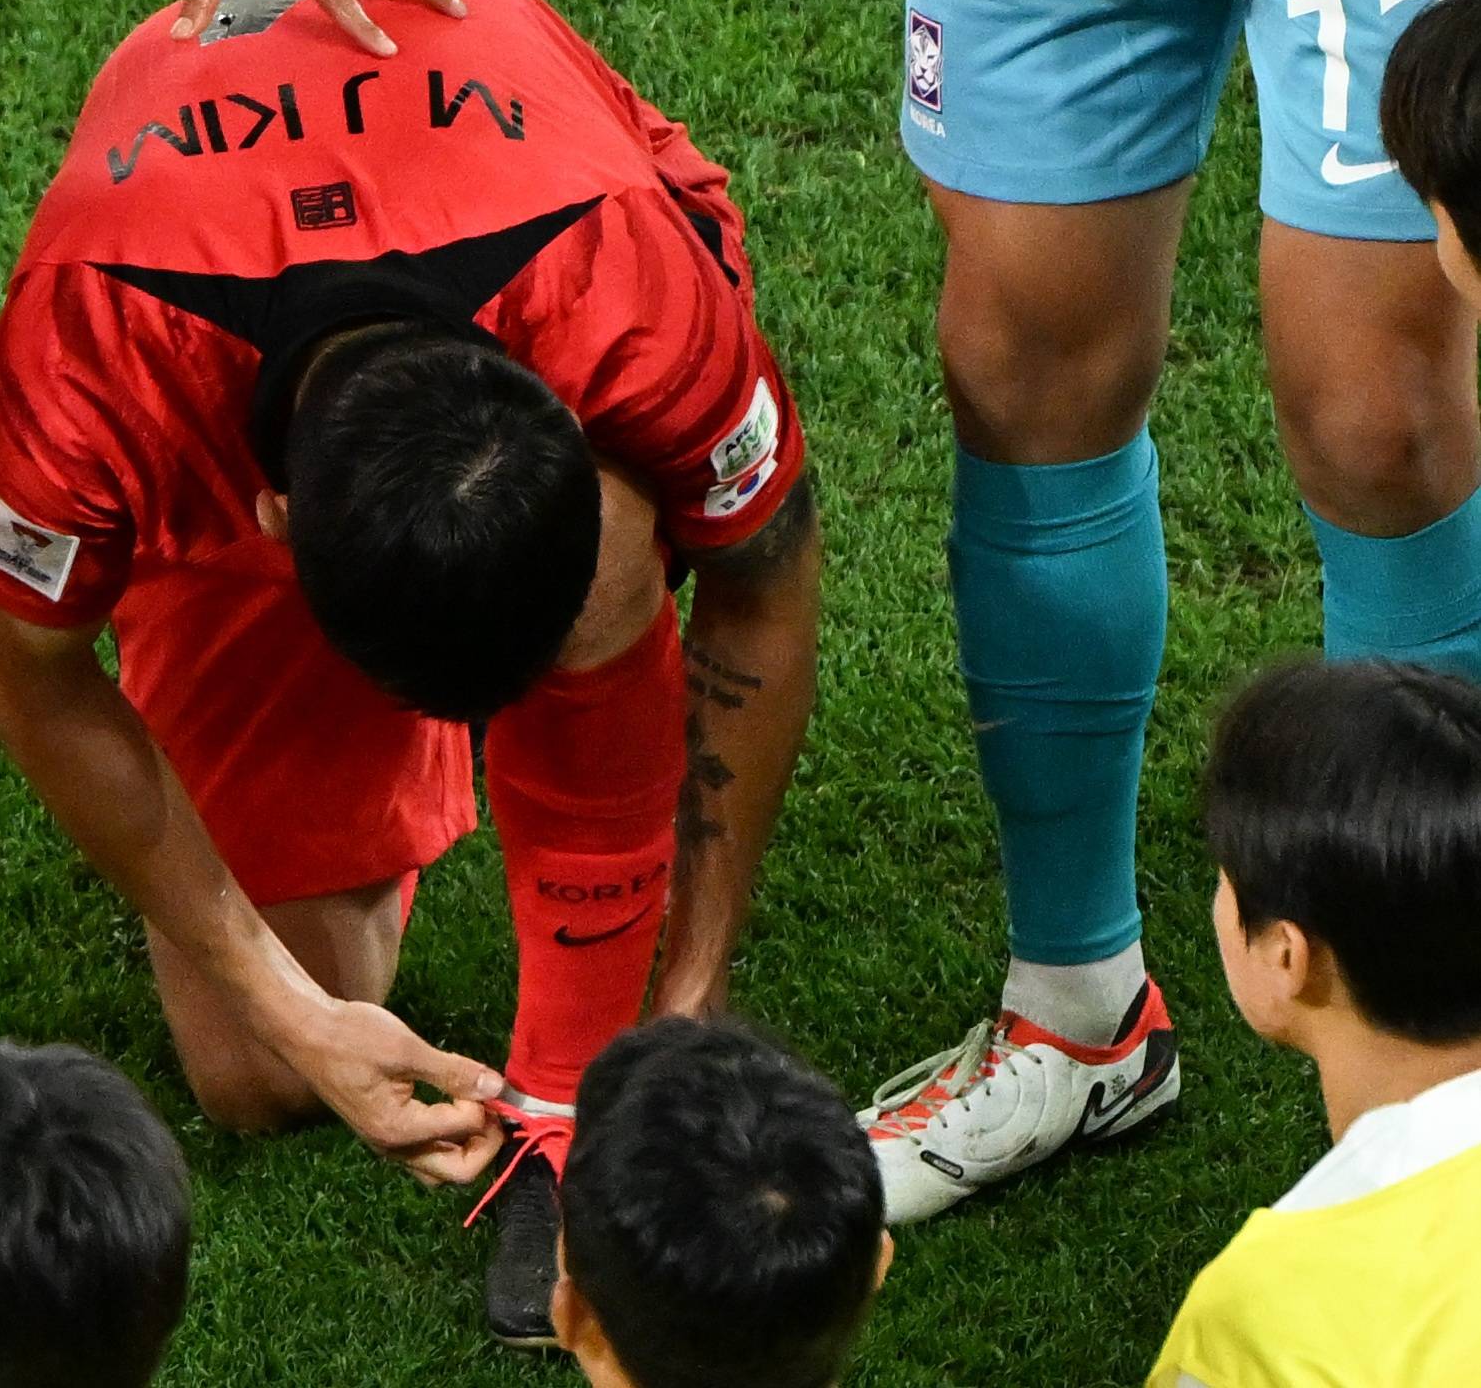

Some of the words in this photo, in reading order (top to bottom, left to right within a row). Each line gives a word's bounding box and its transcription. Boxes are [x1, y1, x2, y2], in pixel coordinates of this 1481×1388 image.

[106, 83, 305, 185] KIM
[342, 70, 380, 135] J
[427, 69, 526, 142] M
[909, 103, 947, 139] KOREA
